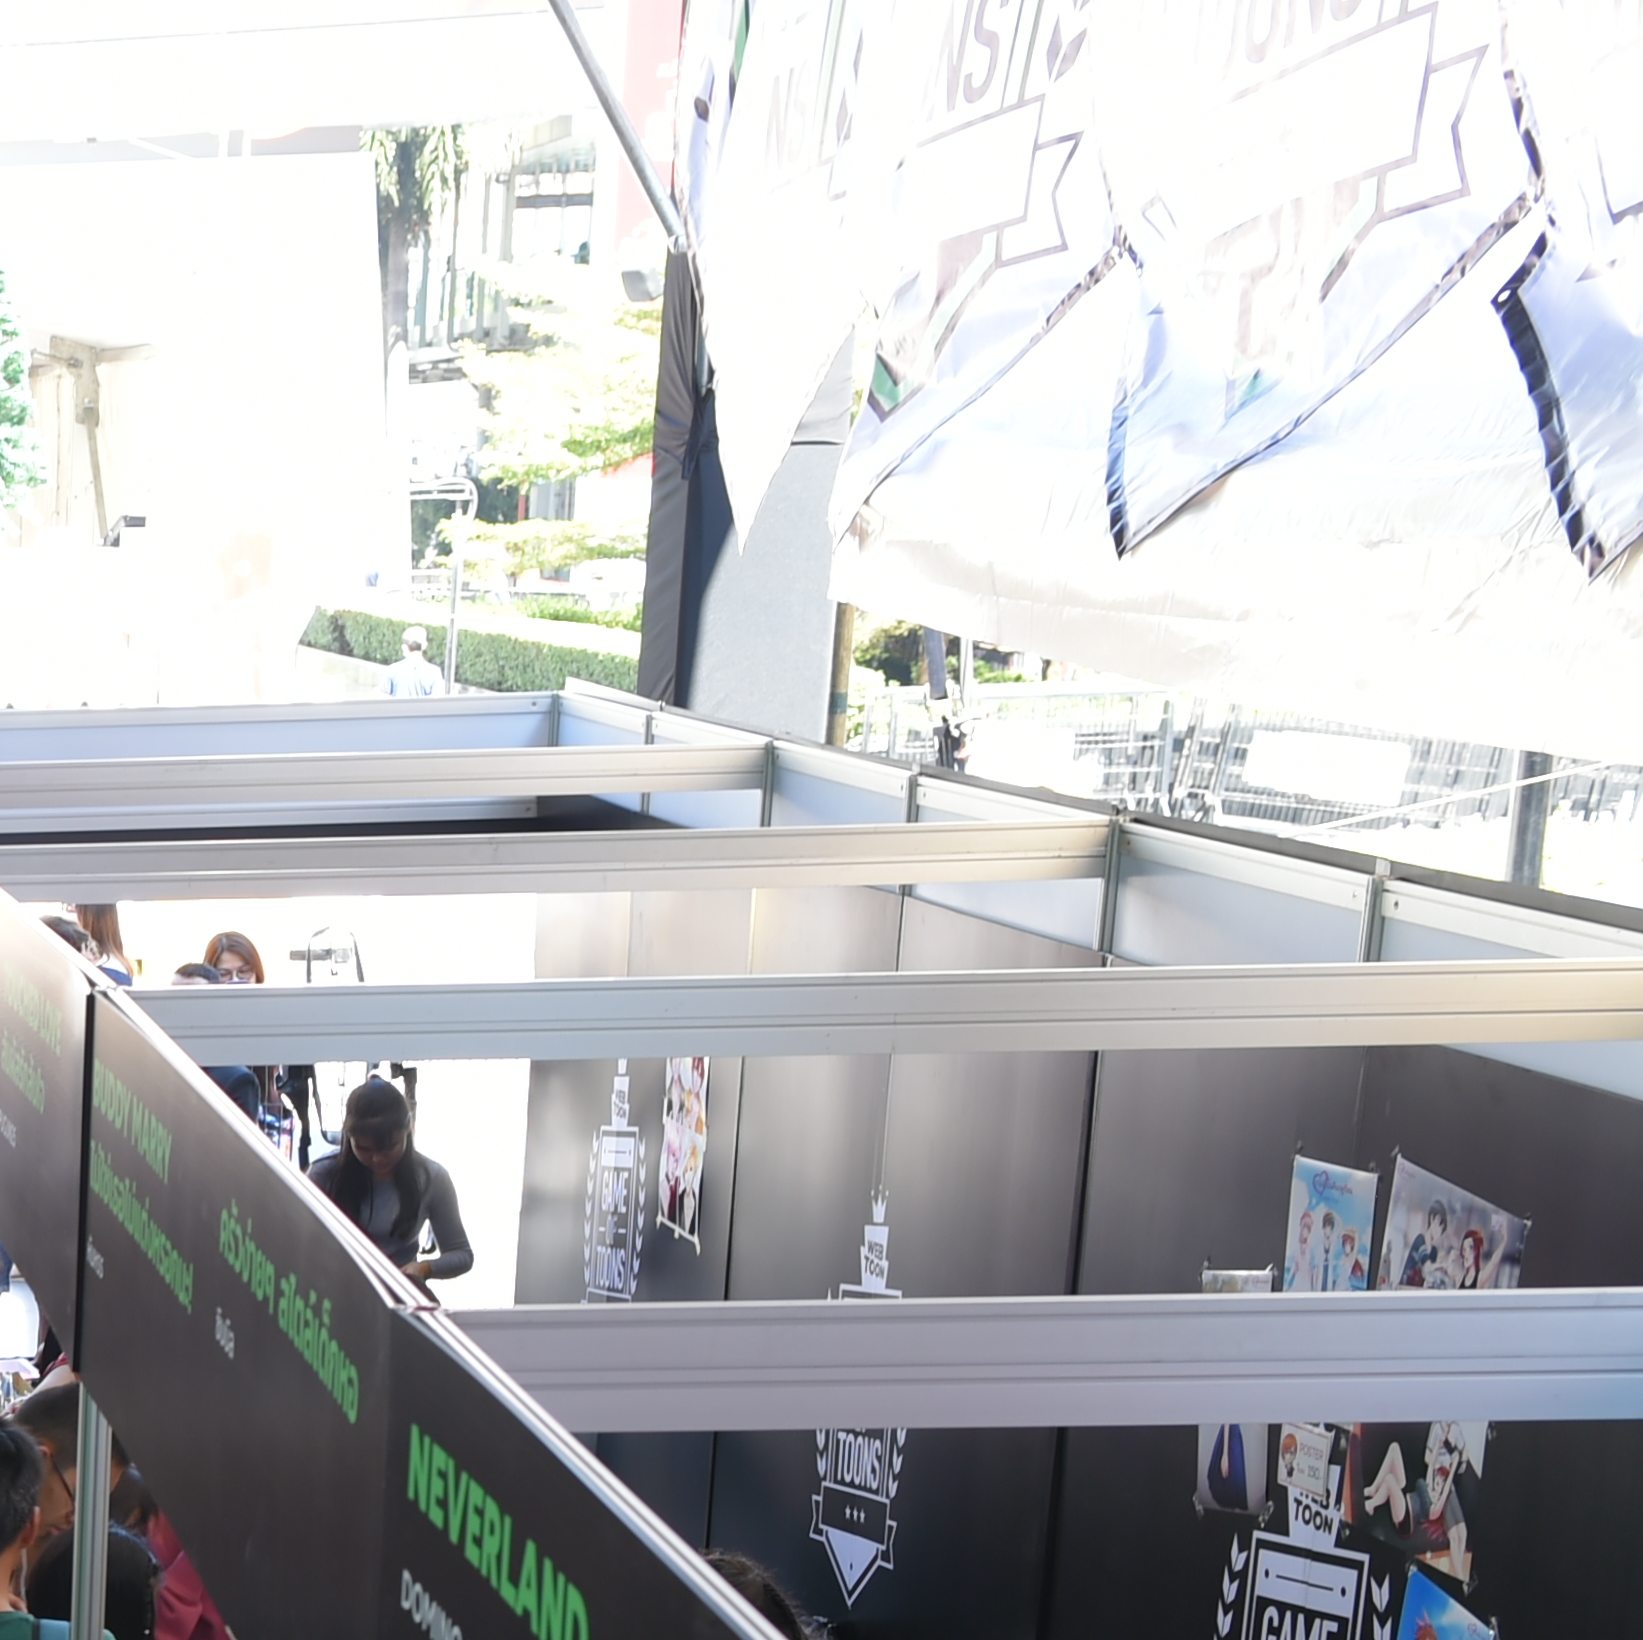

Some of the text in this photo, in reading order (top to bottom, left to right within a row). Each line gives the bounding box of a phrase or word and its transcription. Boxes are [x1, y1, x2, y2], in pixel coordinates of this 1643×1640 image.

[93, 1057, 173, 1185] BUDDY MARRY
[864, 1256, 886, 1280] TOON
[867, 1239, 885, 1261] WEB
[837, 1431, 882, 1490] TOONS
[1293, 1496, 1334, 1536] TOON
